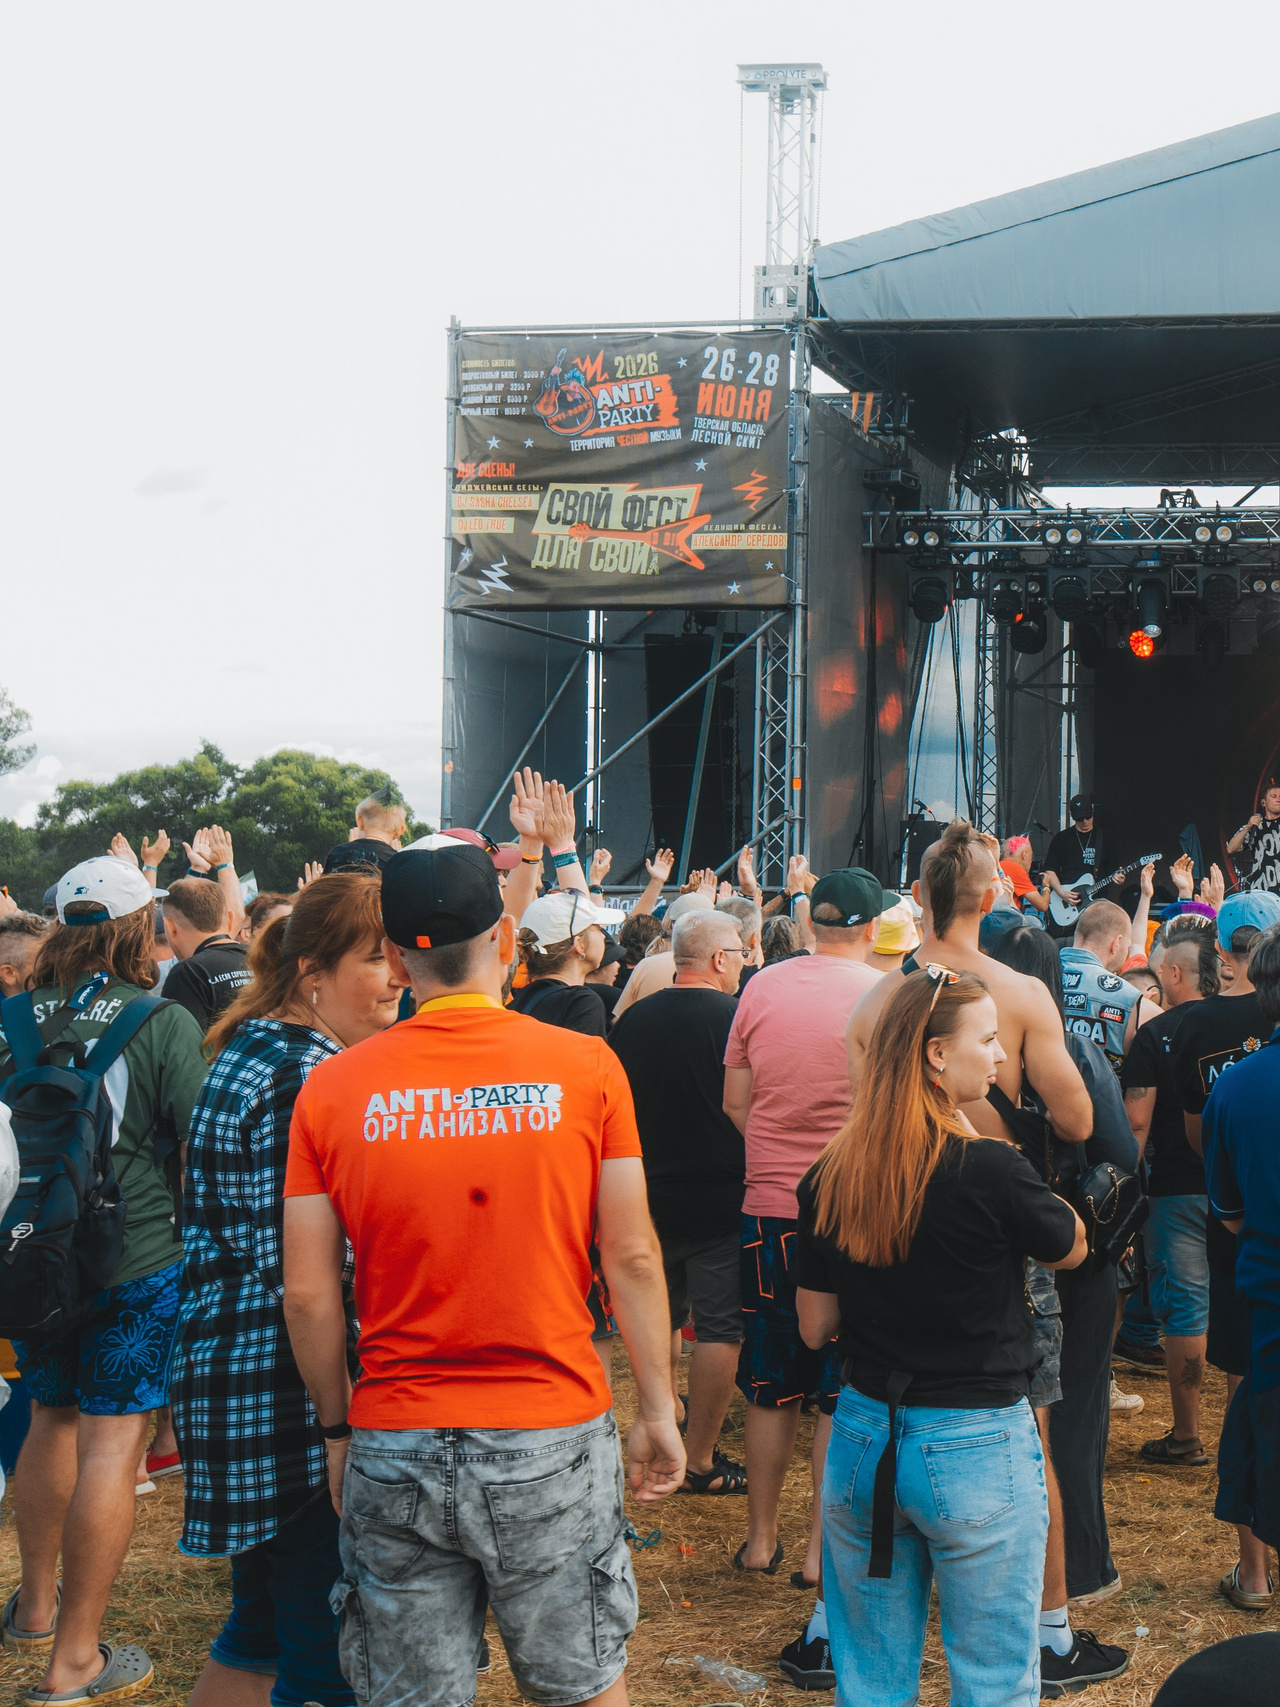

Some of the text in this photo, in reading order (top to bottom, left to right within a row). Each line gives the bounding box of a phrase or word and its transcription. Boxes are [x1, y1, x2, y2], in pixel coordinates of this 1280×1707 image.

[614, 351, 658, 379] 2026
[597, 380, 662, 409] ANTI-
[696, 382, 772, 422] ИЮНЯ
[598, 404, 655, 428] PARTY
[694, 417, 729, 431] ТВЕРСКАЯ
[570, 428, 681, 451] ТЕРРИТОРИЯ ЧЕСТНОЙ МУЗЫКИ
[691, 429, 762, 449] ЛЕСНОЙ СКИТ
[478, 462, 516, 478] СЦЕНЫ!
[457, 495, 533, 508] DJ SASHA CHELSEA
[546, 487, 687, 531] СВОЙ ФЕСТ
[458, 518, 507, 531] DJ LEO TRUE
[704, 523, 746, 531] ВЕДУЩИЙ
[693, 534, 742, 547] АЛЕКСАНДР
[531, 535, 582, 570] ДЛЯ
[363, 1107, 562, 1142] ОРГАНИЗАТОР
